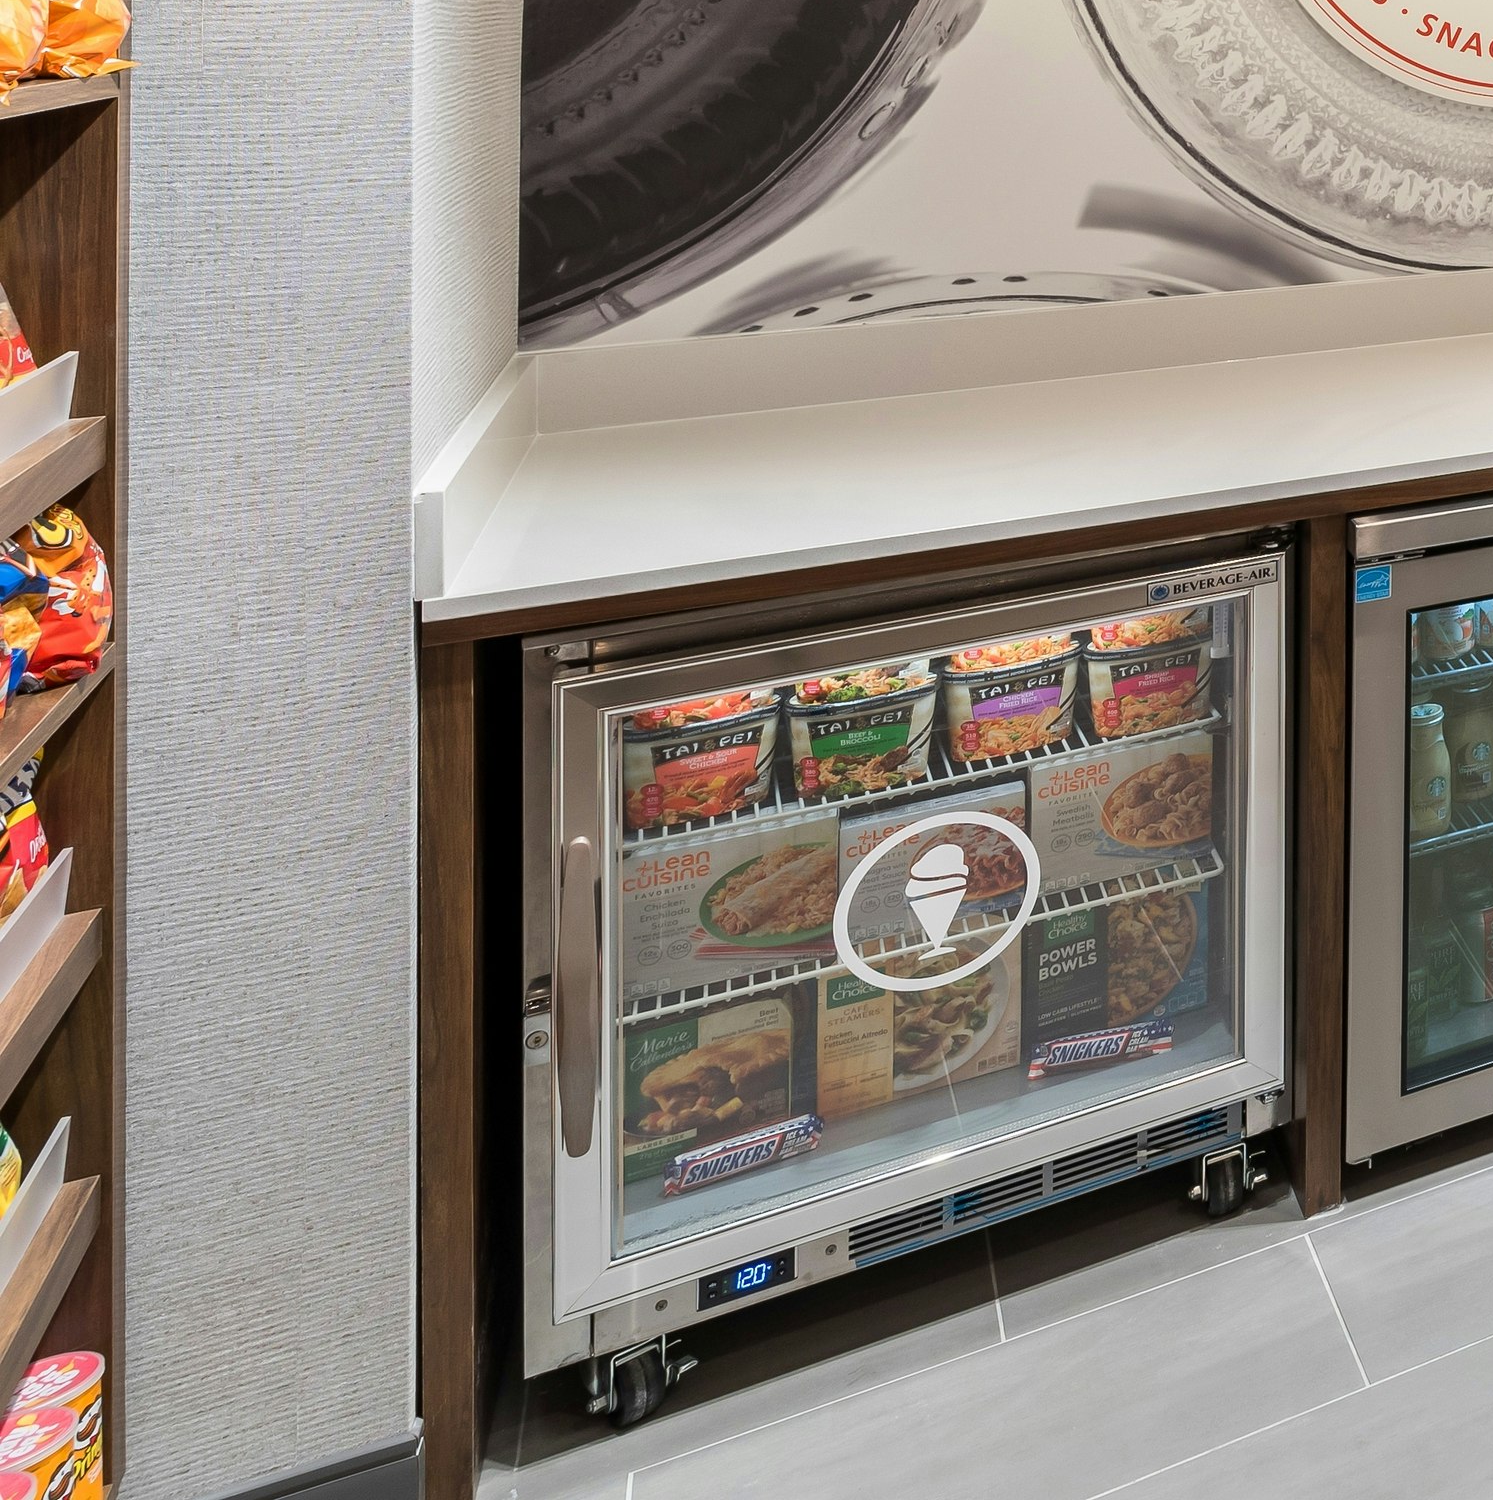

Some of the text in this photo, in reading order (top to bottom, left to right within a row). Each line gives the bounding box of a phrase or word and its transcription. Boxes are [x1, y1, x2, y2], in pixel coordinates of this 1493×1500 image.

[1118, 655, 1191, 677] TAI PEI
[978, 674, 1055, 700] TAI PEI
[1159, 675, 1176, 684] RICE
[999, 694, 1038, 708] FRIED RICE
[1003, 690, 1034, 702] CHICKEN
[817, 711, 901, 735] TAI PEI
[662, 731, 752, 760] TAI PEI
[840, 733, 881, 745] BROCCOLI
[689, 757, 727, 770] CHICKEN
[1064, 761, 1110, 785] Lean
[1052, 811, 1094, 825] Meatballs
[1056, 804, 1091, 817] Swedish
[654, 850, 711, 874] Lean
[1048, 922, 1088, 940] Choice
[1039, 938, 1096, 965] POWER
[1039, 952, 1097, 980] BOWLS
[1049, 1037, 1125, 1064] SNICKERS
[683, 1140, 777, 1185] SNICKERS
